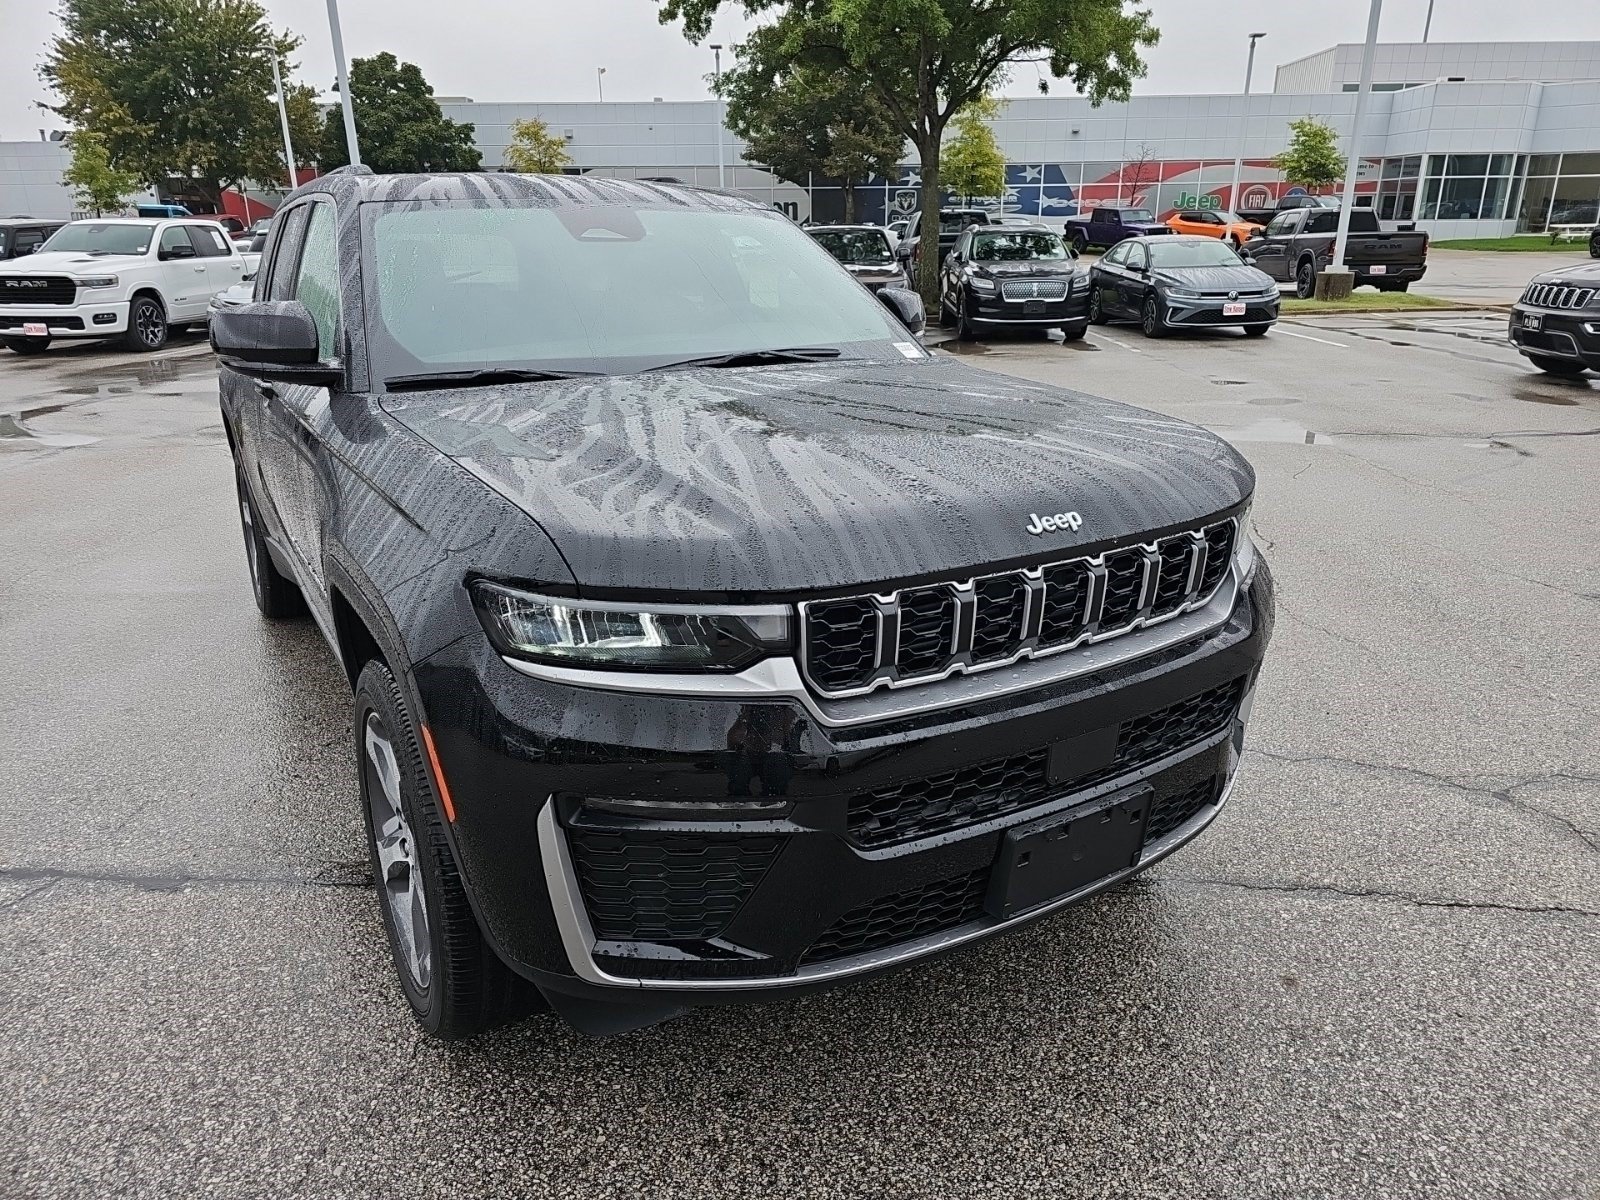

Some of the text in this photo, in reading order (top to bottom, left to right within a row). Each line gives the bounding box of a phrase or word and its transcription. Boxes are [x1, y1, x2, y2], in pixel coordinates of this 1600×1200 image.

[1173, 191, 1222, 209] Jeep
[1248, 194, 1266, 208] FIAT
[5, 280, 48, 288] RAM
[1025, 511, 1083, 535] Jeep
